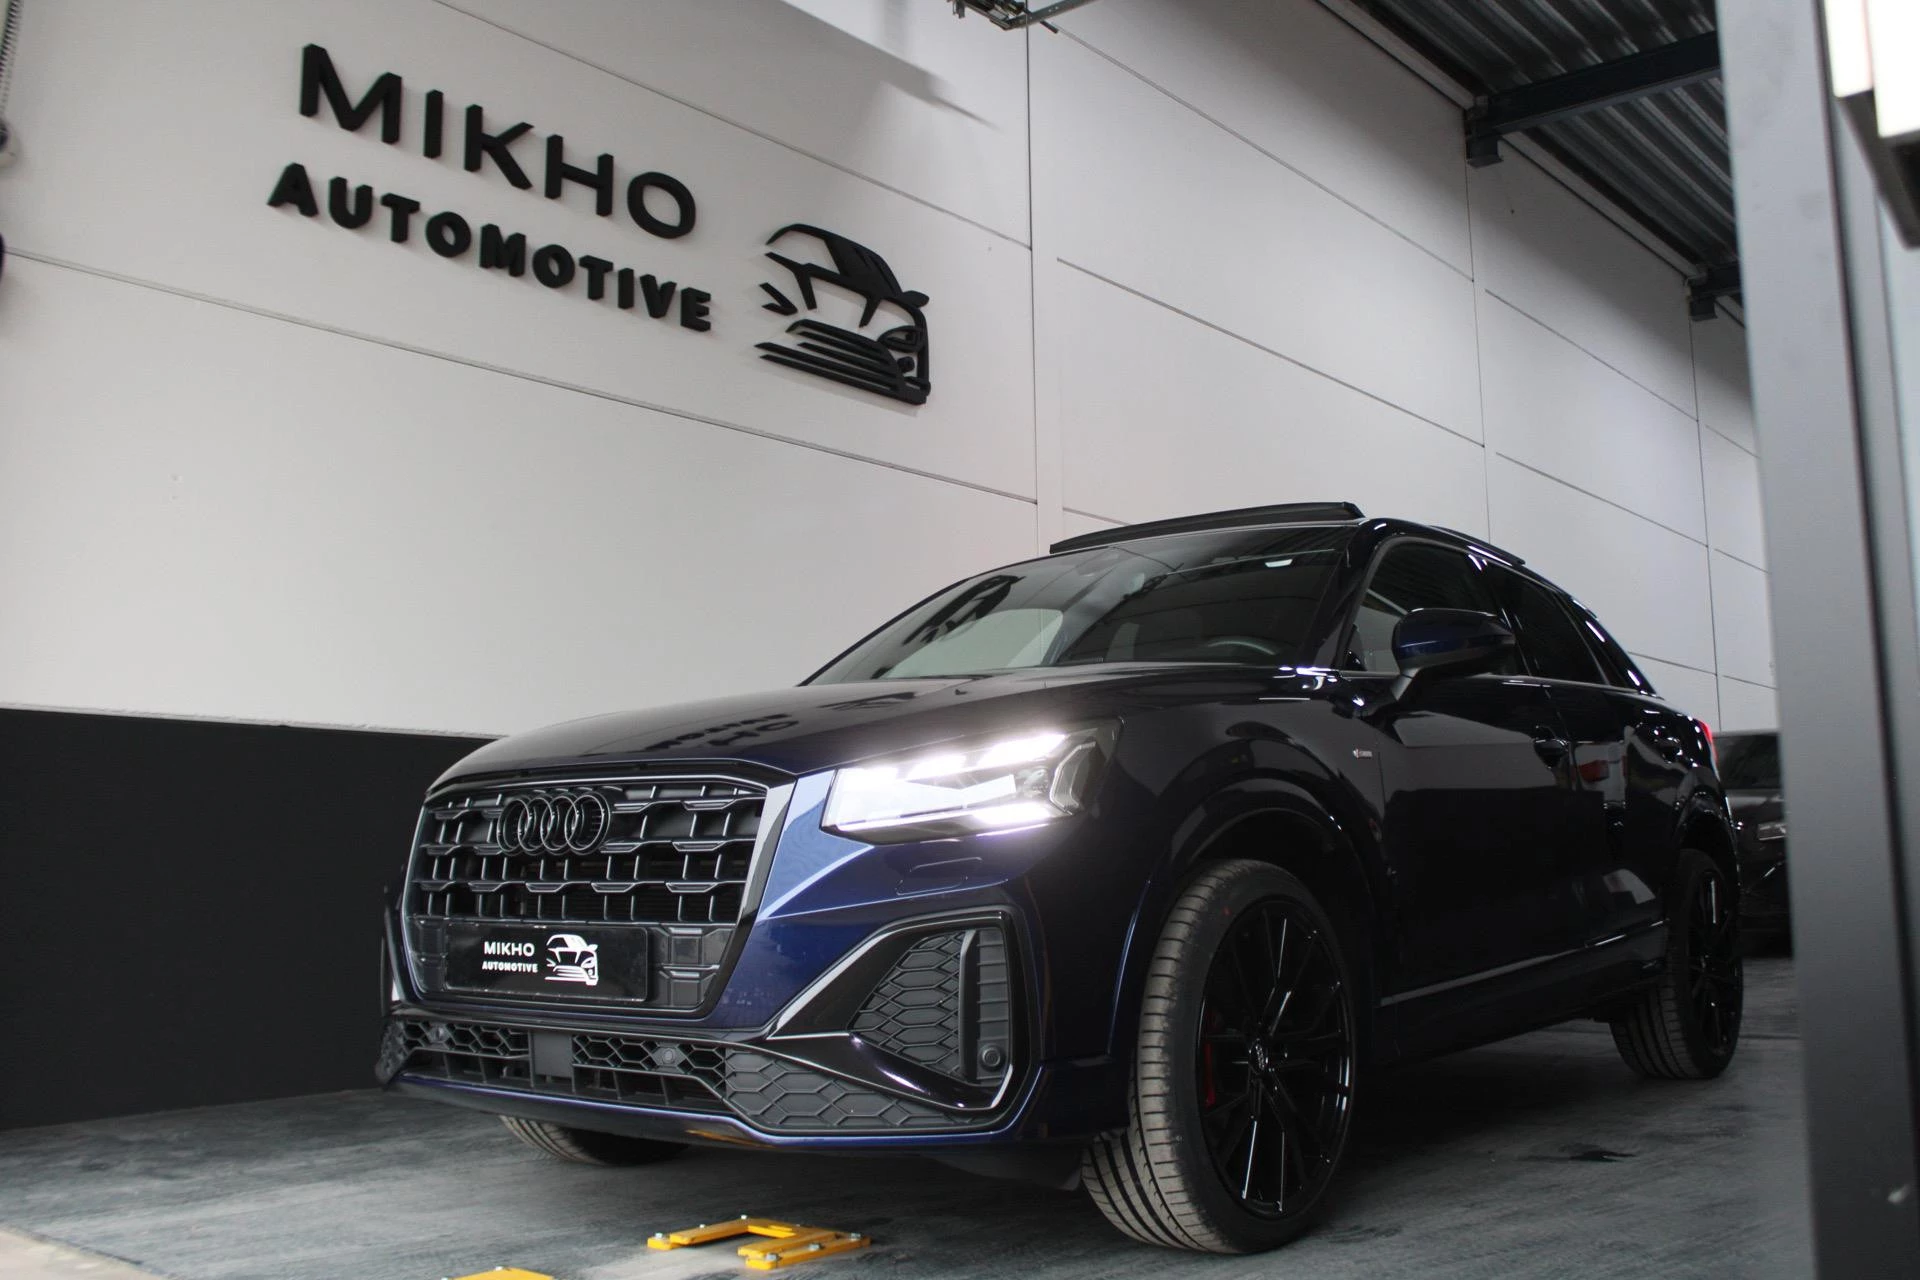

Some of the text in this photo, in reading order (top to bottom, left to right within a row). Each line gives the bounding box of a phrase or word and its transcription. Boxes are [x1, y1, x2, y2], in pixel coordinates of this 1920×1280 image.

[298, 43, 697, 239] MIKHO
[267, 162, 712, 332] AUTOMOTIVE
[482, 961, 538, 973] AUTOMOTIVE
[484, 941, 535, 957] MIKHO
